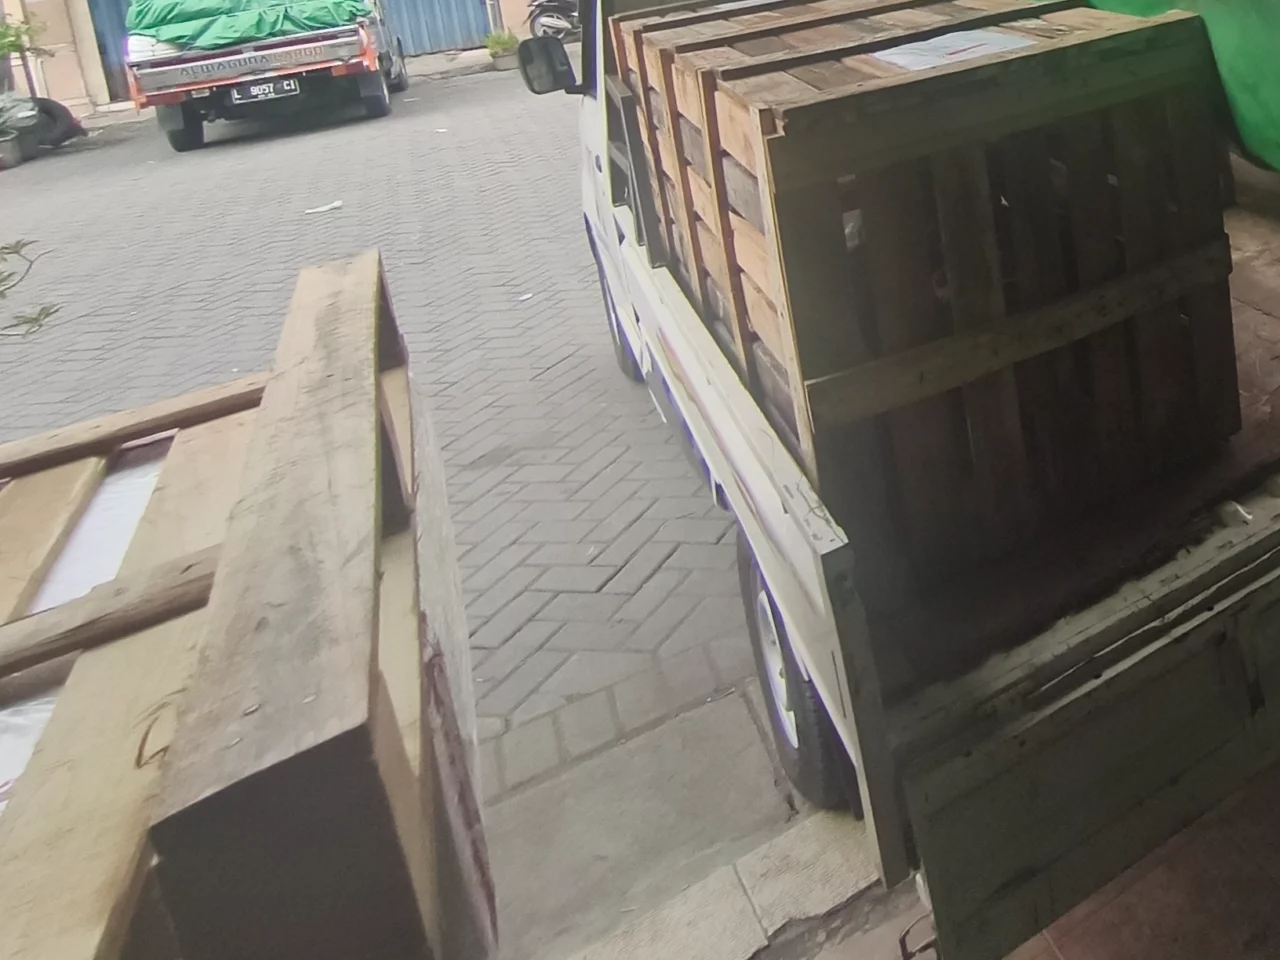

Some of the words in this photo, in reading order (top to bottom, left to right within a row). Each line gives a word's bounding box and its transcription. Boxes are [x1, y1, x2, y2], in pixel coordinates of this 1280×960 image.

[274, 47, 325, 60] CARGO
[233, 88, 242, 99] L
[250, 83, 274, 96] 9057
